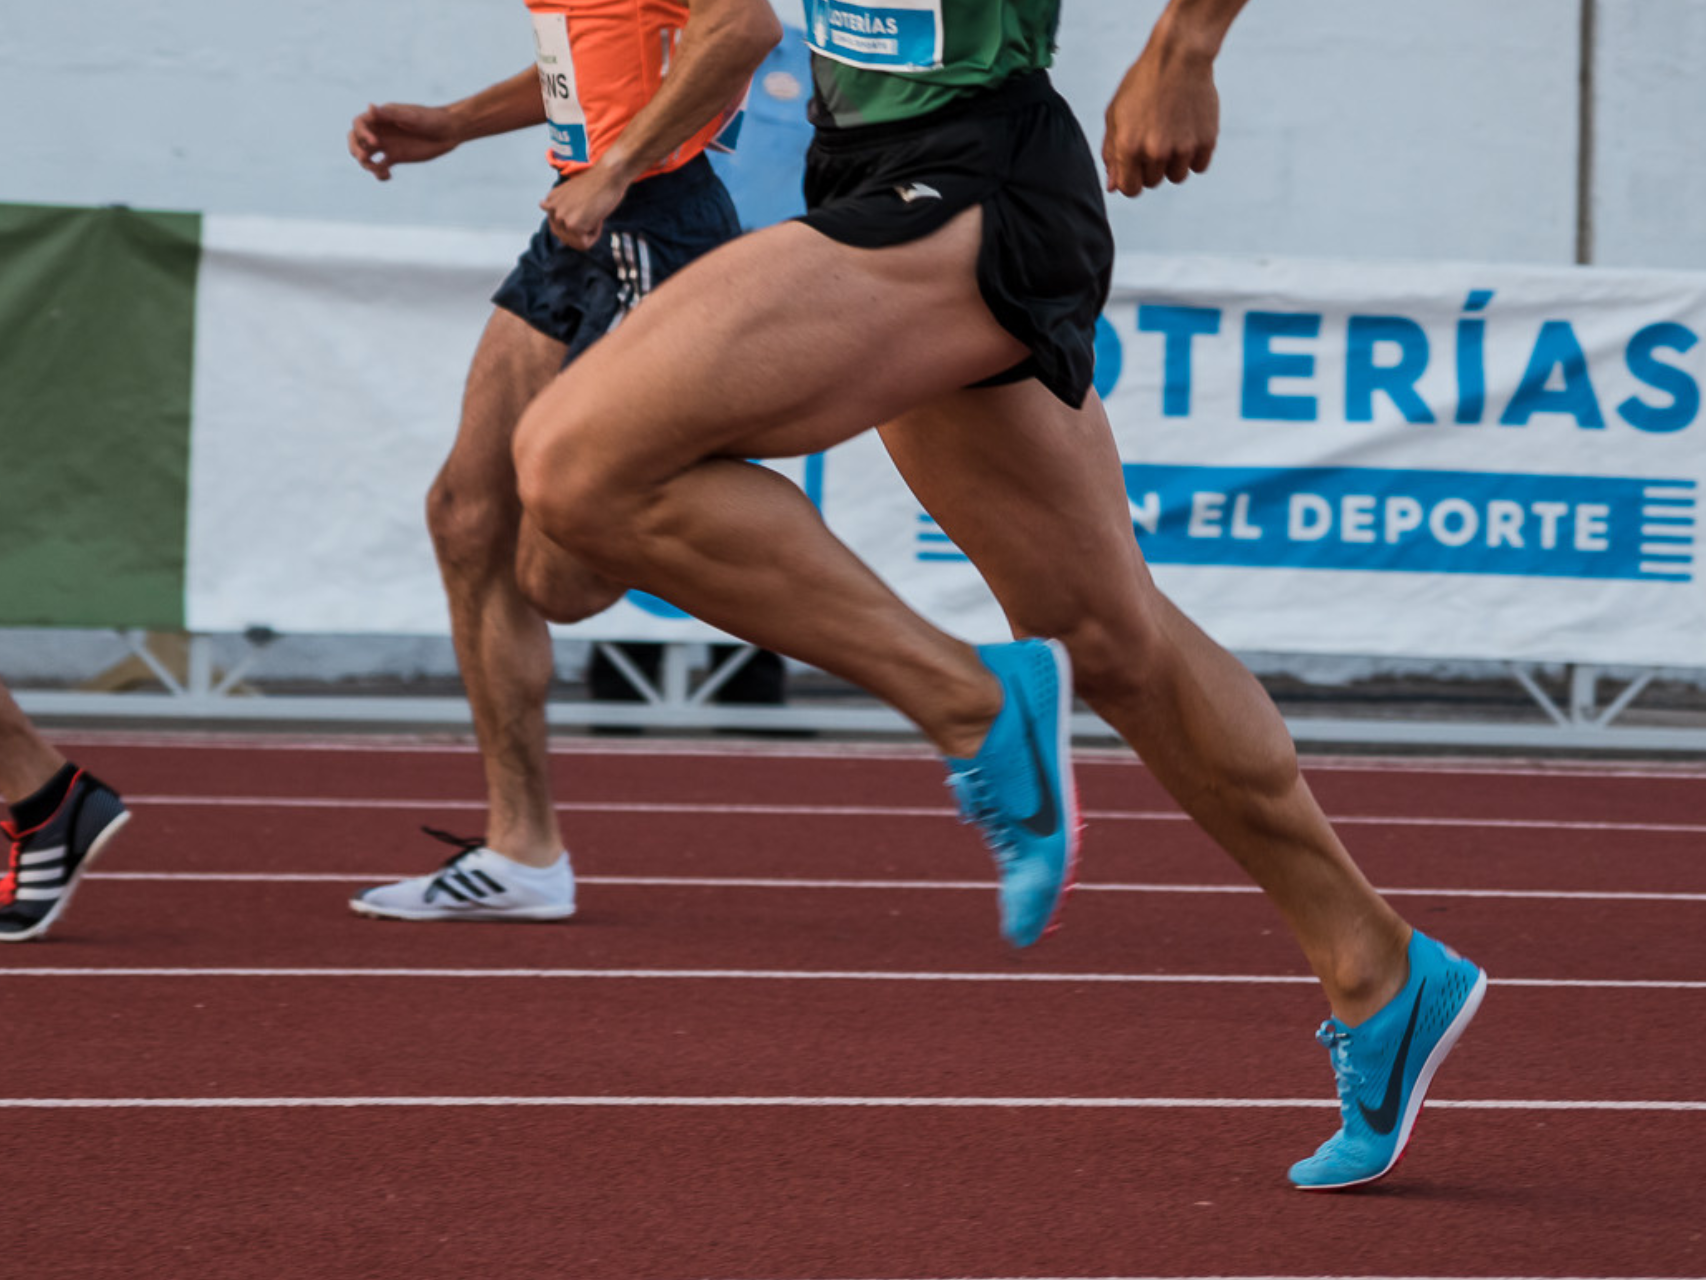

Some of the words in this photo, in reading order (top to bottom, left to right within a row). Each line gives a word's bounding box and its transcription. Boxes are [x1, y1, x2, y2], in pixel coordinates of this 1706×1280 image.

[1093, 290, 1700, 433] TERÍAS
[1128, 491, 1160, 534] N
[1188, 491, 1263, 539] EL
[1287, 494, 1609, 551] DEPORTE
